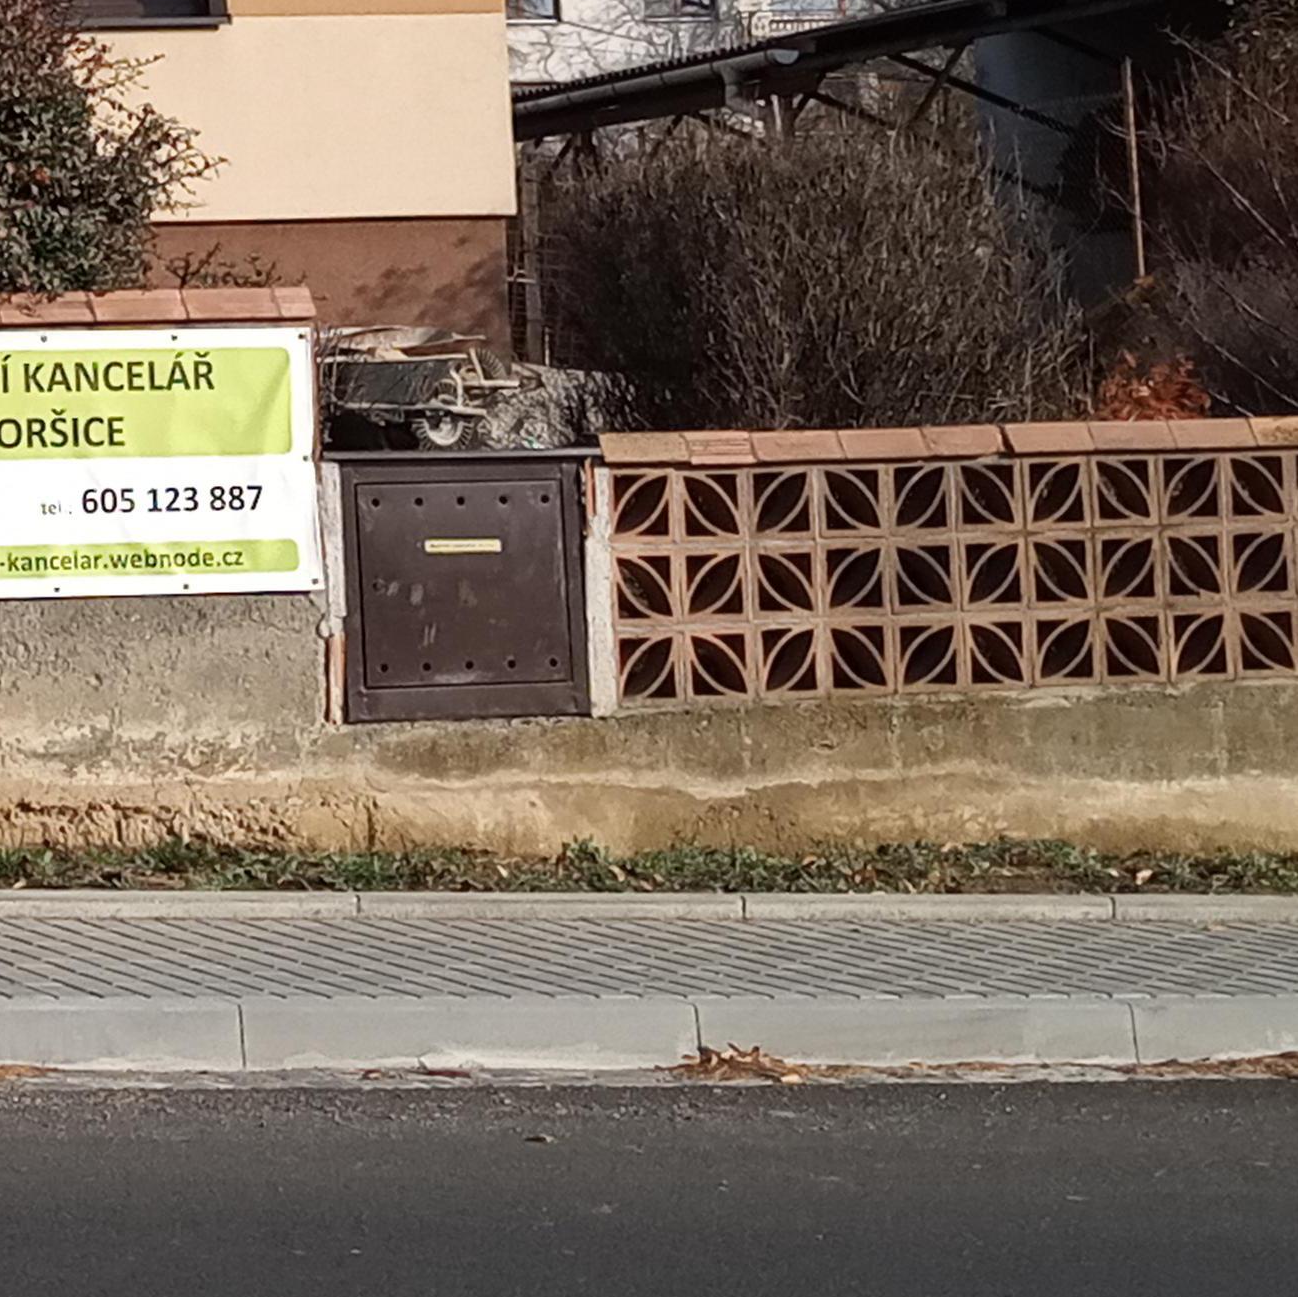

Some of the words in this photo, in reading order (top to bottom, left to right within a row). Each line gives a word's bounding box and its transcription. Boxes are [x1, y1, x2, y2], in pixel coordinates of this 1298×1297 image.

[23, 352, 215, 393] KANCELÁŘ
[82, 488, 135, 514] 605
[147, 486, 199, 513] 123
[209, 485, 263, 511] 887
